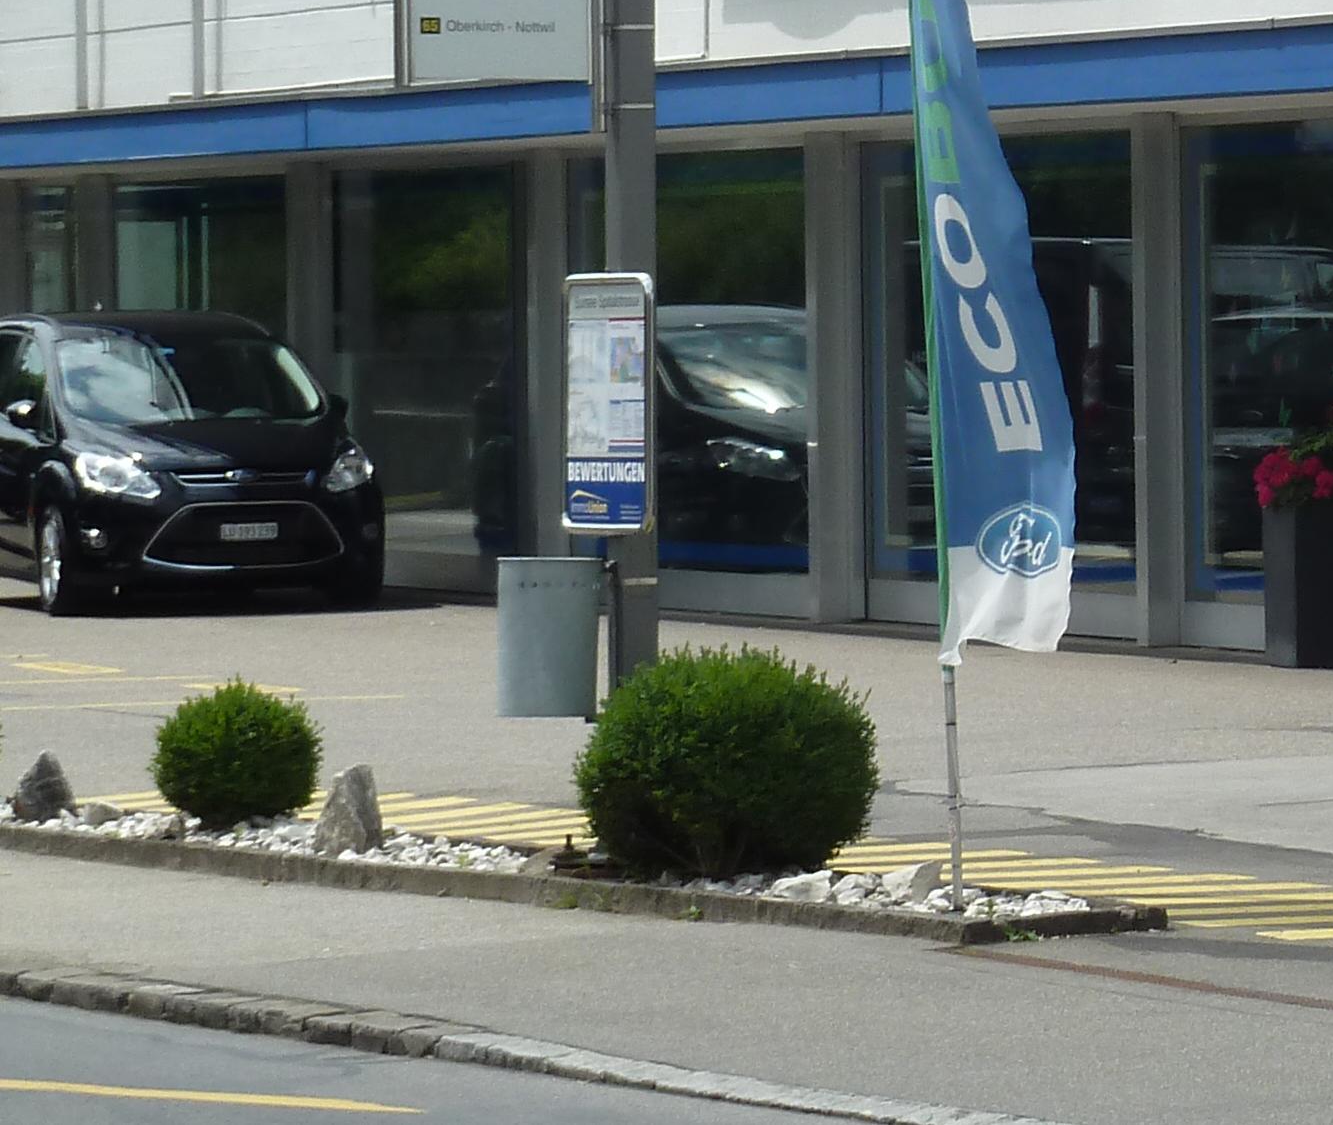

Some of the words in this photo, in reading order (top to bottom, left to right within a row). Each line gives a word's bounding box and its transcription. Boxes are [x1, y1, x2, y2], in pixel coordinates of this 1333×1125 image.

[446, 19, 504, 33] Oberkirch
[515, 21, 556, 34] Nottwil
[567, 461, 646, 483] BEWERTUNGEN
